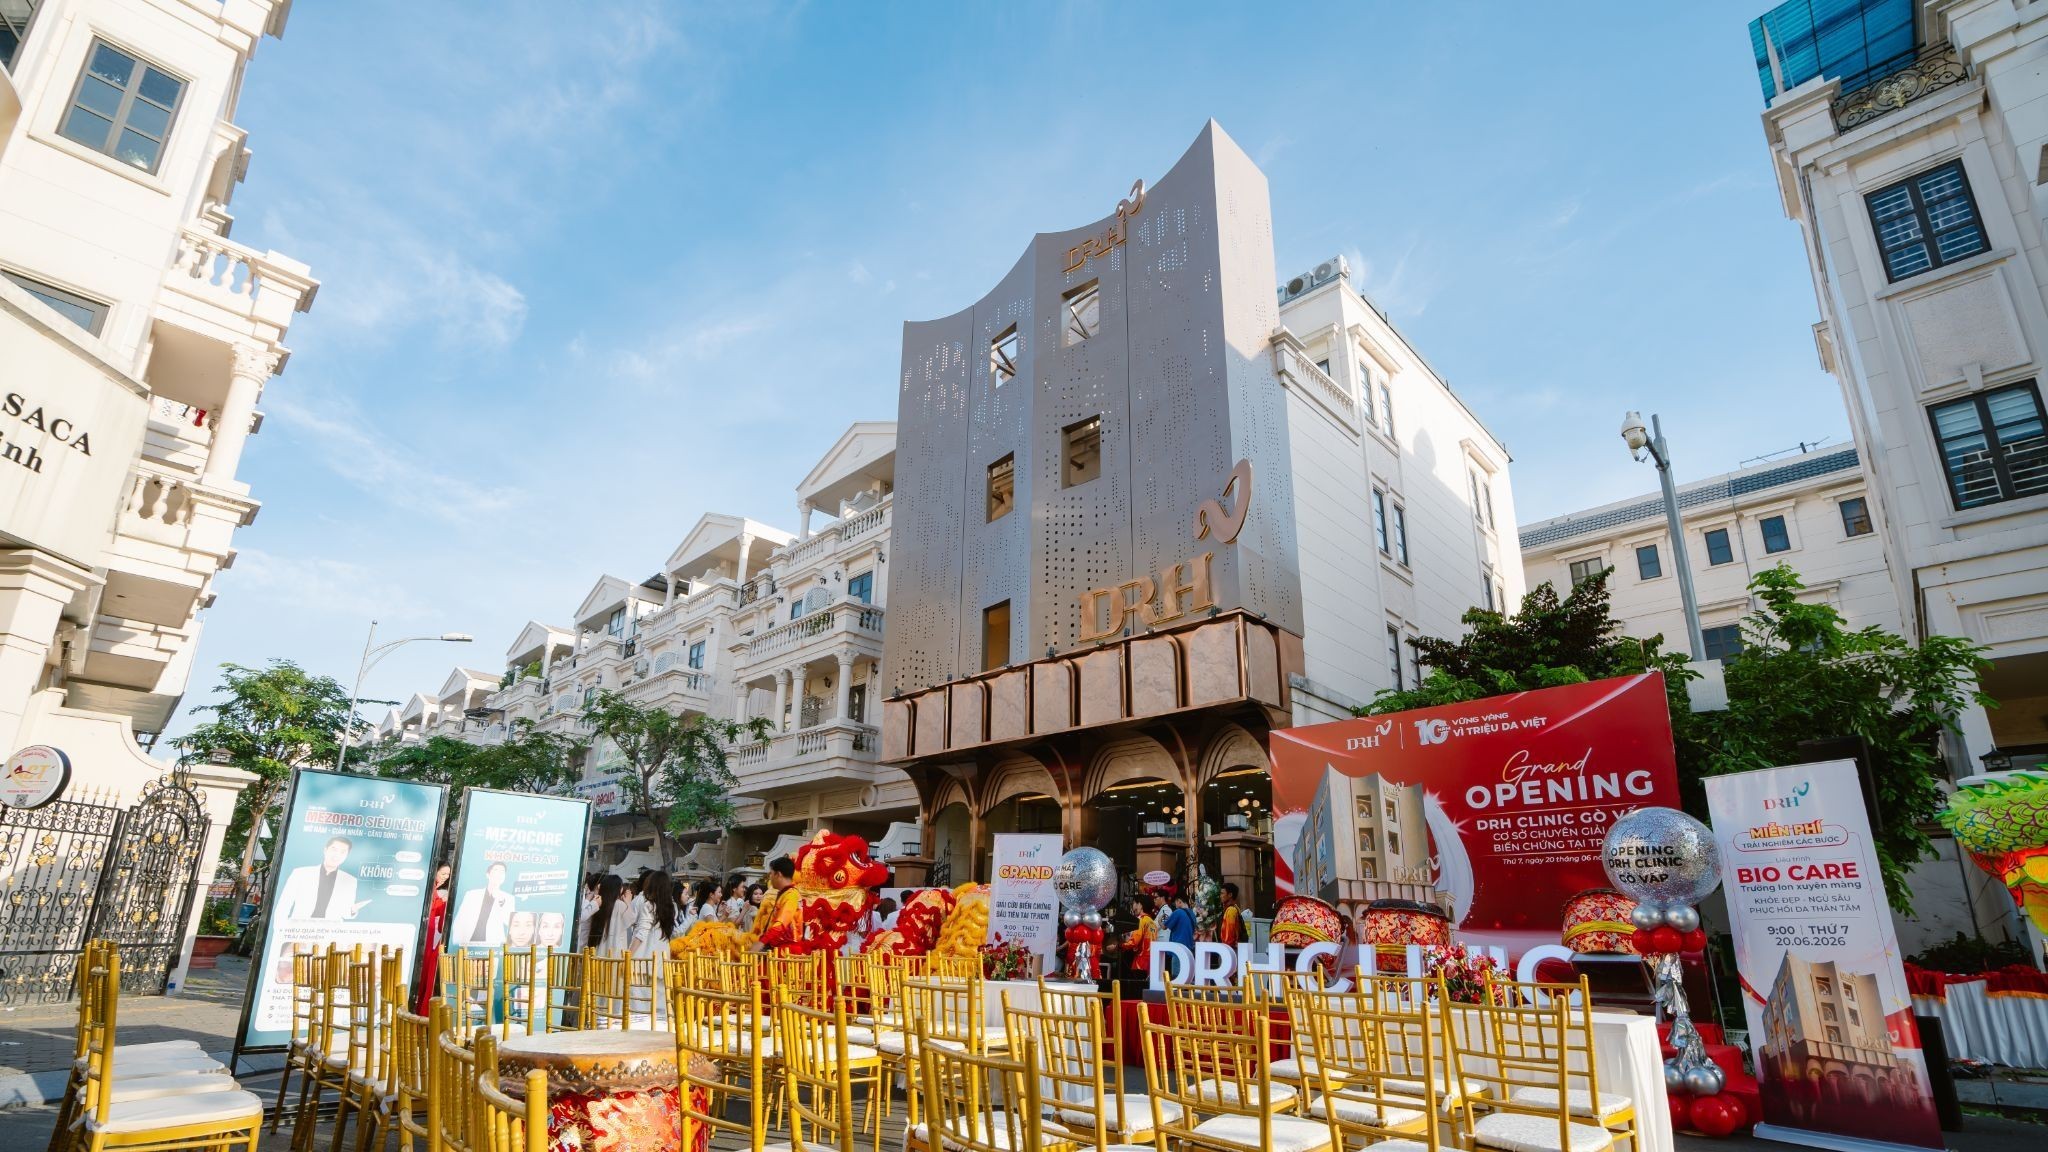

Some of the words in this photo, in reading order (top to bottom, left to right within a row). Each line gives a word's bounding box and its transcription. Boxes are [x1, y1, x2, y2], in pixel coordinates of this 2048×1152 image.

[1062, 214, 1127, 273] DRH
[1, 392, 91, 456] SACA
[1078, 552, 1214, 643] DRH
[1415, 717, 1449, 746] 10
[1466, 723, 1499, 736] TRIỆU
[1501, 722, 1518, 731] DA
[1522, 716, 1547, 728] VIỆT
[1347, 734, 1380, 751] DRH
[1502, 747, 1592, 788] Grand
[1465, 769, 1654, 809] OPENING
[359, 799, 385, 810] DRH
[1763, 796, 1801, 810] DRH
[304, 809, 364, 827] MEZOPRO
[1476, 817, 1512, 831] DRH
[1517, 813, 1574, 828] CLINIC
[1580, 809, 1607, 824] GÒ
[484, 826, 564, 847] MEZOCORE
[1493, 832, 1509, 841] CƠ
[1511, 828, 1527, 840] SỞ
[1529, 826, 1578, 839] CHUYÊN
[1581, 824, 1606, 836] GIẢI
[1750, 822, 1790, 839] MIỄN
[1792, 818, 1824, 836] PHÍ
[1493, 841, 1520, 853] BIẾN
[1522, 840, 1565, 851] CHỨNG
[1567, 839, 1586, 850] TẠI
[1610, 845, 1674, 857] OPENING
[1525, 857, 1544, 865] ngày
[1555, 855, 1579, 864] tháng
[1581, 854, 1592, 862] 06
[1608, 858, 1631, 868] DRH
[1635, 856, 1683, 869] CLINIC
[360, 864, 393, 879] KHÔNG
[998, 864, 1054, 880] GRAND
[1619, 872, 1636, 884] GÒ
[1737, 866, 1781, 884] BIO
[1788, 862, 1859, 881] CARE
[1059, 881, 1082, 890] CARE
[1796, 881, 1828, 891] xuyên
[1767, 925, 1795, 935] 9:00
[1807, 923, 1837, 935] THỨ
[1840, 925, 1849, 934] 7
[1776, 936, 1846, 946] 20.06.2026
[1150, 941, 1285, 999] DRH
